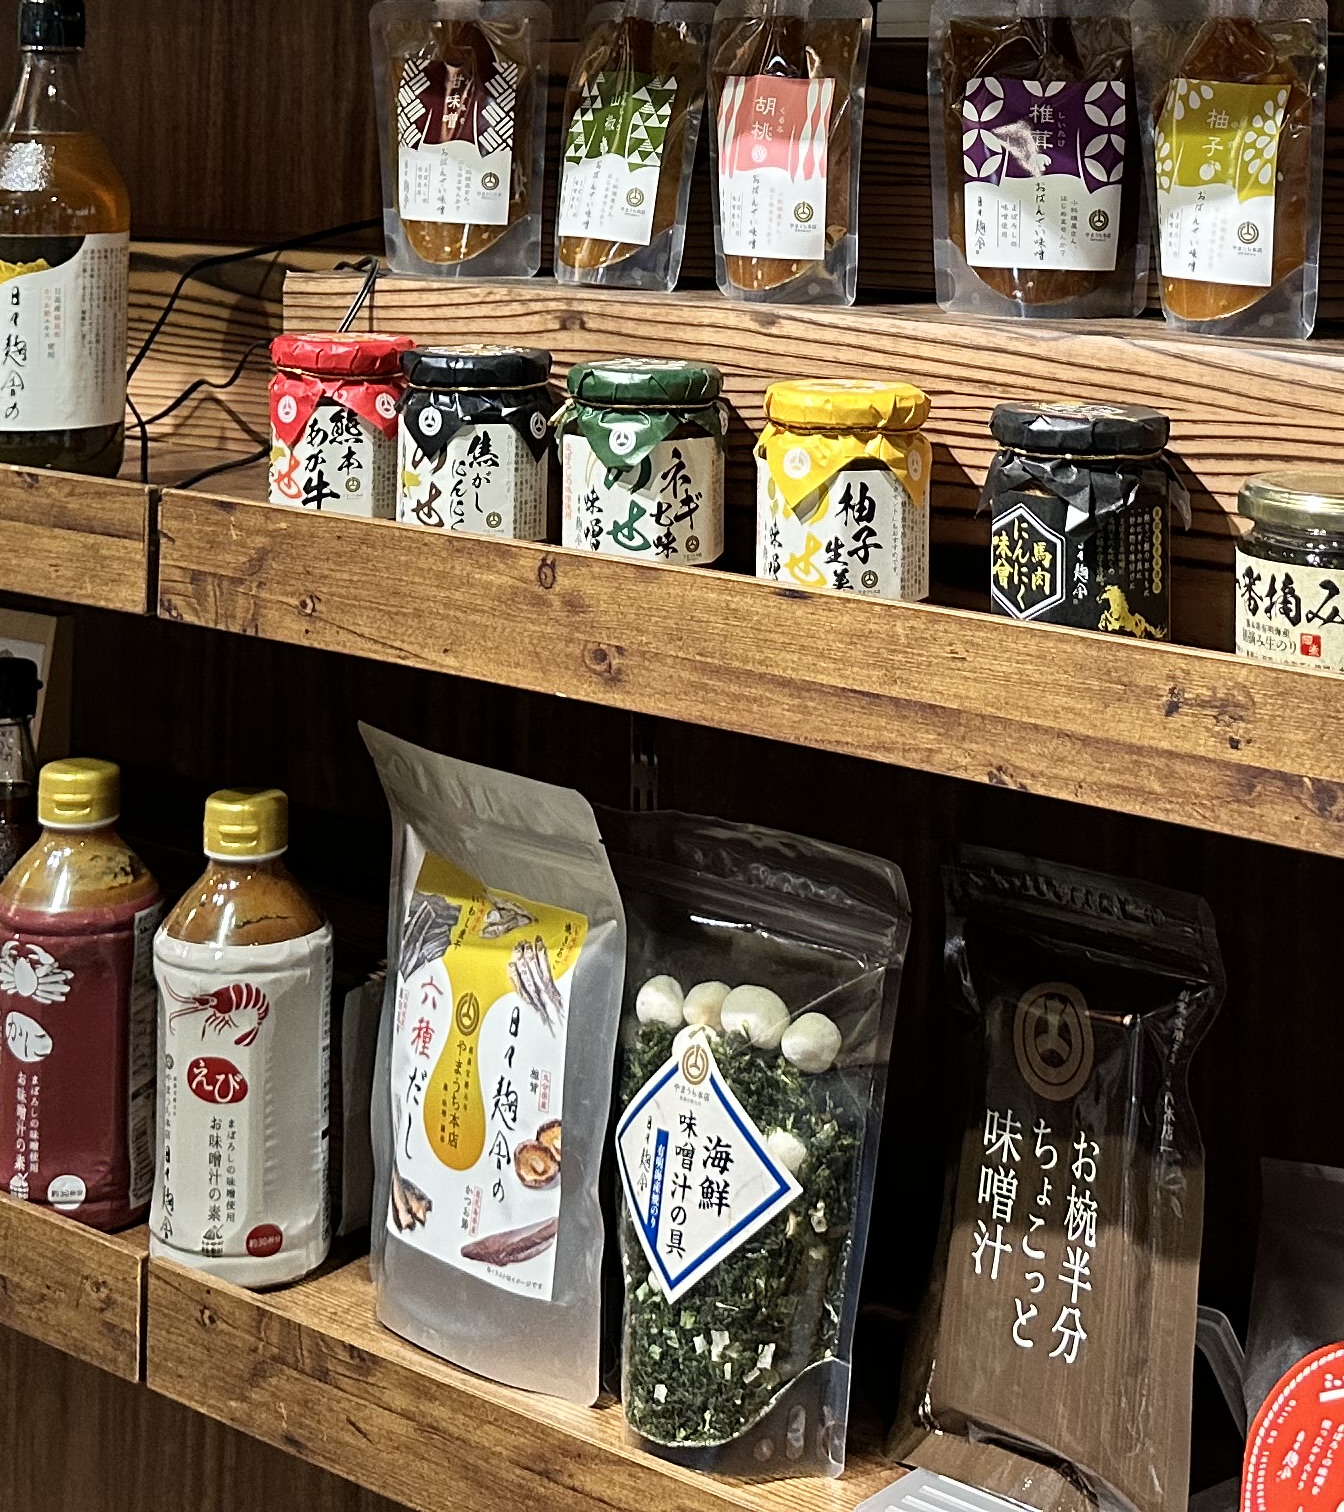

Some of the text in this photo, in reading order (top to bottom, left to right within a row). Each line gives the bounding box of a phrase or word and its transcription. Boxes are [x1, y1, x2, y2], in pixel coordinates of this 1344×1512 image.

[751, 96, 777, 143] 胡桃
[1028, 103, 1055, 151] 椎茸
[1202, 108, 1229, 157] 柚子
[301, 418, 341, 510] あか牛
[328, 408, 363, 476] 熊本
[467, 431, 500, 514] 焦がし
[583, 487, 605, 552] 味噌
[651, 501, 679, 558] 七味
[659, 447, 703, 530] ネギ
[835, 482, 884, 565] 柚子
[1011, 517, 1029, 611] にんにく
[1031, 541, 1053, 594] 馬肉
[191, 1059, 244, 1104] えび
[404, 974, 444, 1161] 六種だし
[447, 1040, 468, 1150] やまうち本店
[489, 1005, 519, 1204] 日々麹舎の
[207, 1115, 223, 1222] お味噌汁の素
[225, 1117, 237, 1224] まぼろしの味噌使用
[666, 1109, 698, 1258] 味噌汁の具
[698, 1135, 734, 1218] 海鮮
[971, 1108, 1024, 1281] 味噌汁
[1011, 1118, 1058, 1349] ちょこっと
[1049, 1130, 1101, 1365] お椀半分
